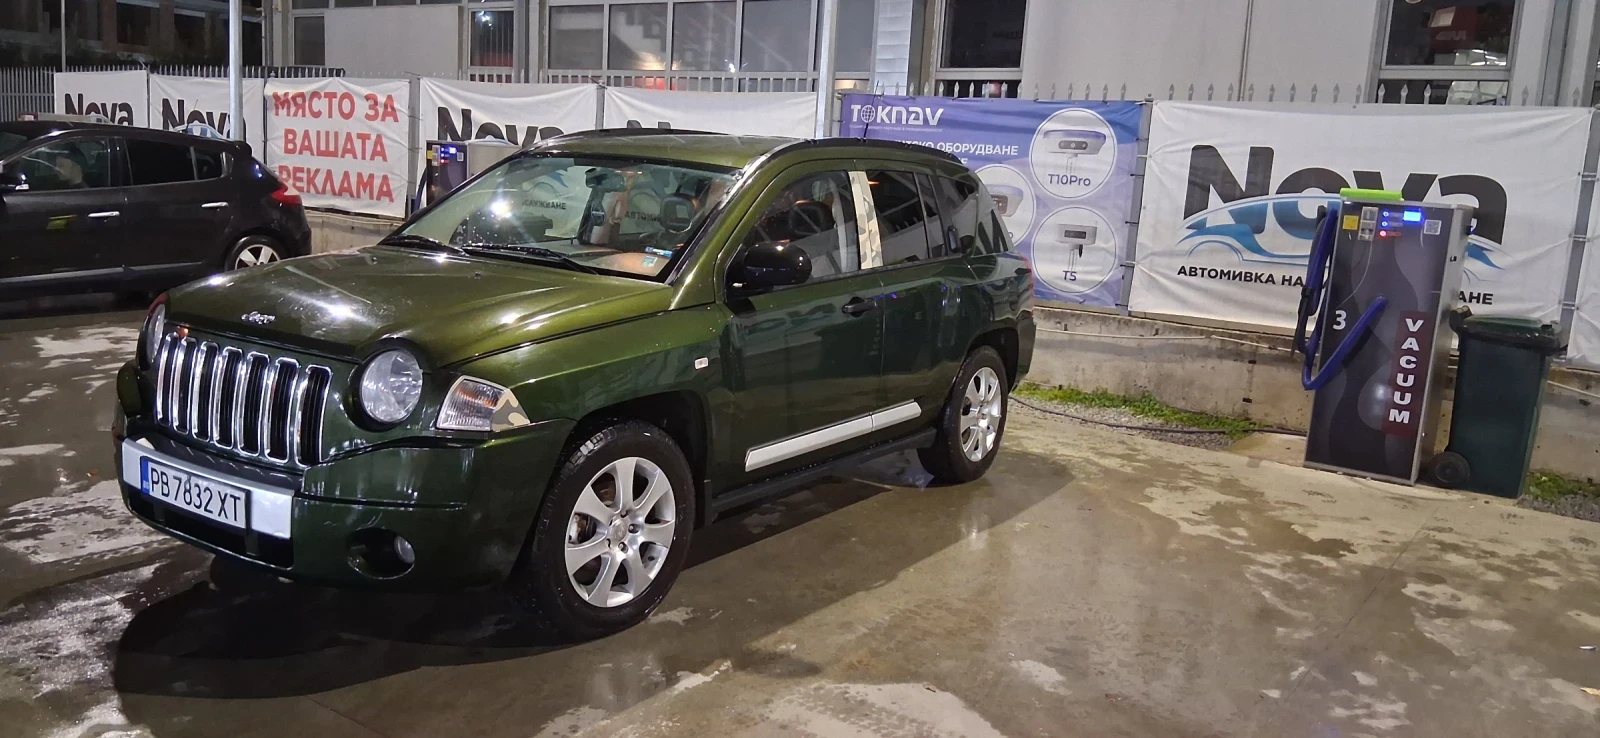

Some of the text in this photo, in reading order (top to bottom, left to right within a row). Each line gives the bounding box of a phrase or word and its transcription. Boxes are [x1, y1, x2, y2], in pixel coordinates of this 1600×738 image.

[65, 93, 133, 126] Nova
[272, 91, 399, 122] МЯСТО ЗА
[283, 128, 388, 162] ВАШАТА
[936, 142, 1018, 156] ОБОРУДВАНЕ
[278, 165, 394, 202] РЕКЛАМА
[1048, 174, 1091, 187] T10Pro
[1063, 270, 1077, 282] T5
[1177, 264, 1276, 285] АВТОМИВКА
[1281, 274, 1304, 287] НА
[1332, 310, 1347, 330] 3
[1388, 317, 1424, 424] VACUUM
